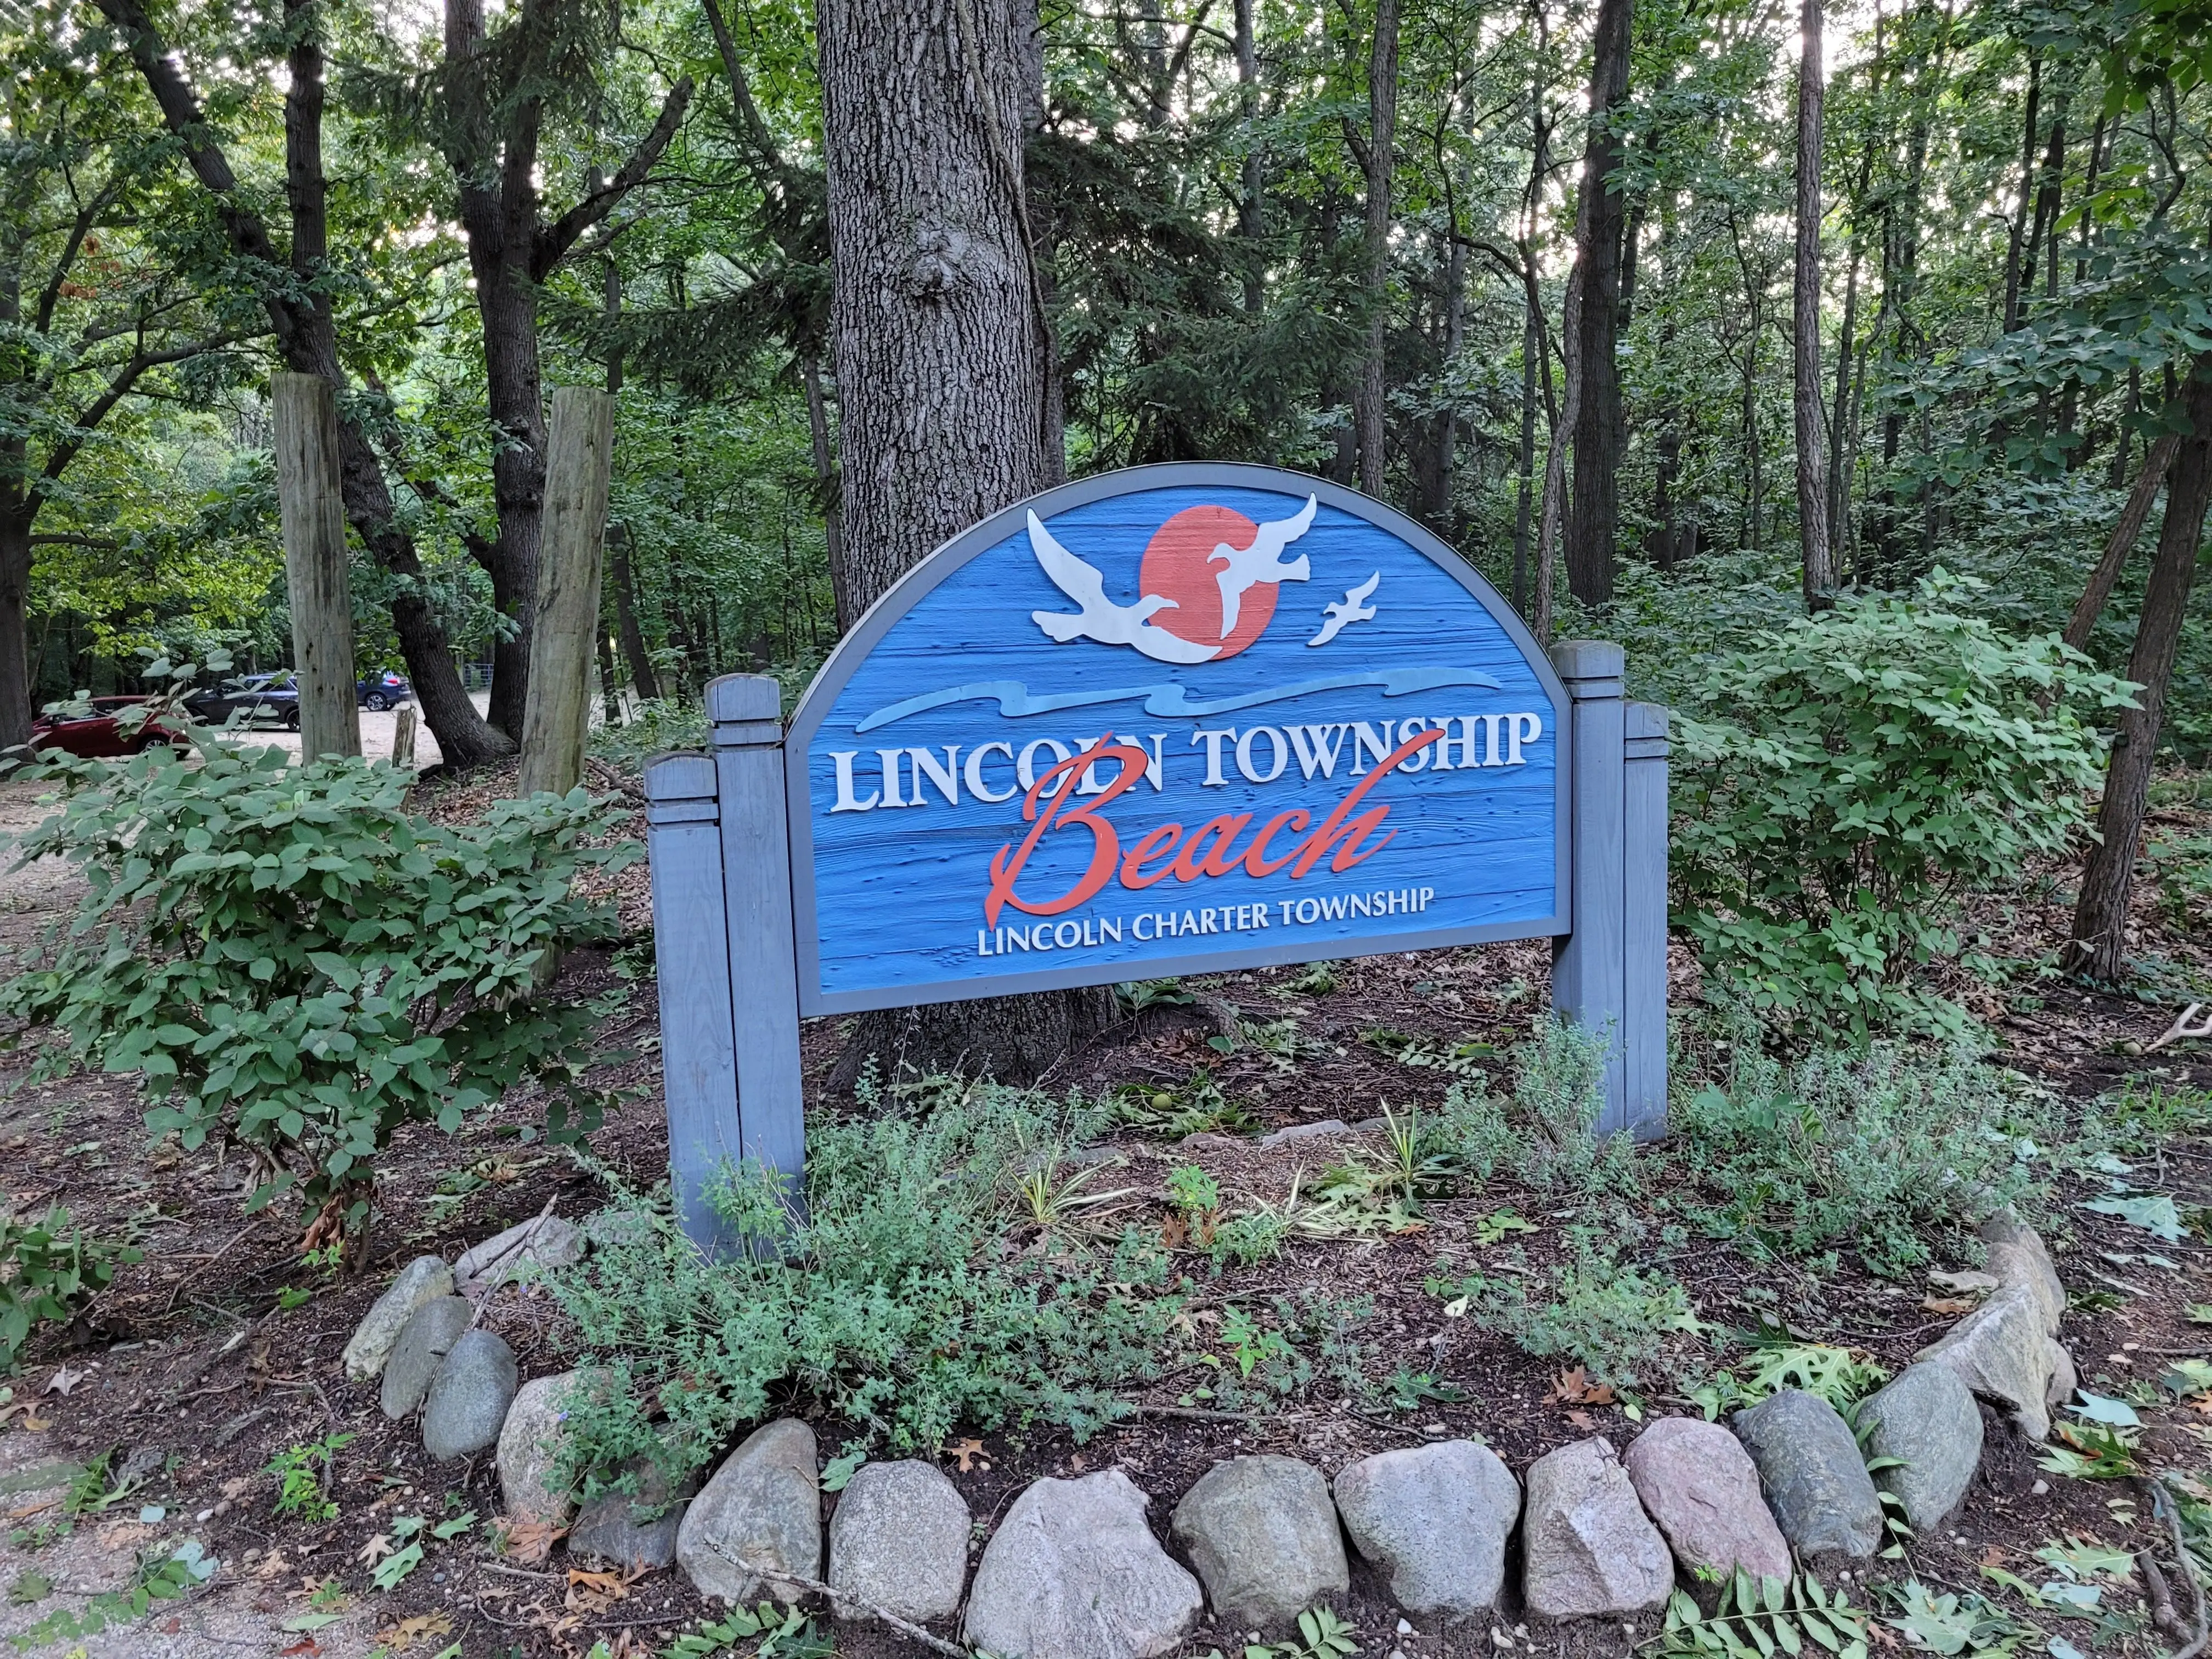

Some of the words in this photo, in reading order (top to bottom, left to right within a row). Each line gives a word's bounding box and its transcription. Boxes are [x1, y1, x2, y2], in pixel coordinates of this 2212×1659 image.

[828, 733, 1167, 812] LINCOLN
[1191, 713, 1542, 786] TOWNSHIP
[985, 730, 1445, 931] Beach
[978, 917, 1122, 956] LINCOLN
[1132, 904, 1269, 939] CHARTER
[1278, 887, 1435, 925] TOWNSHIP
